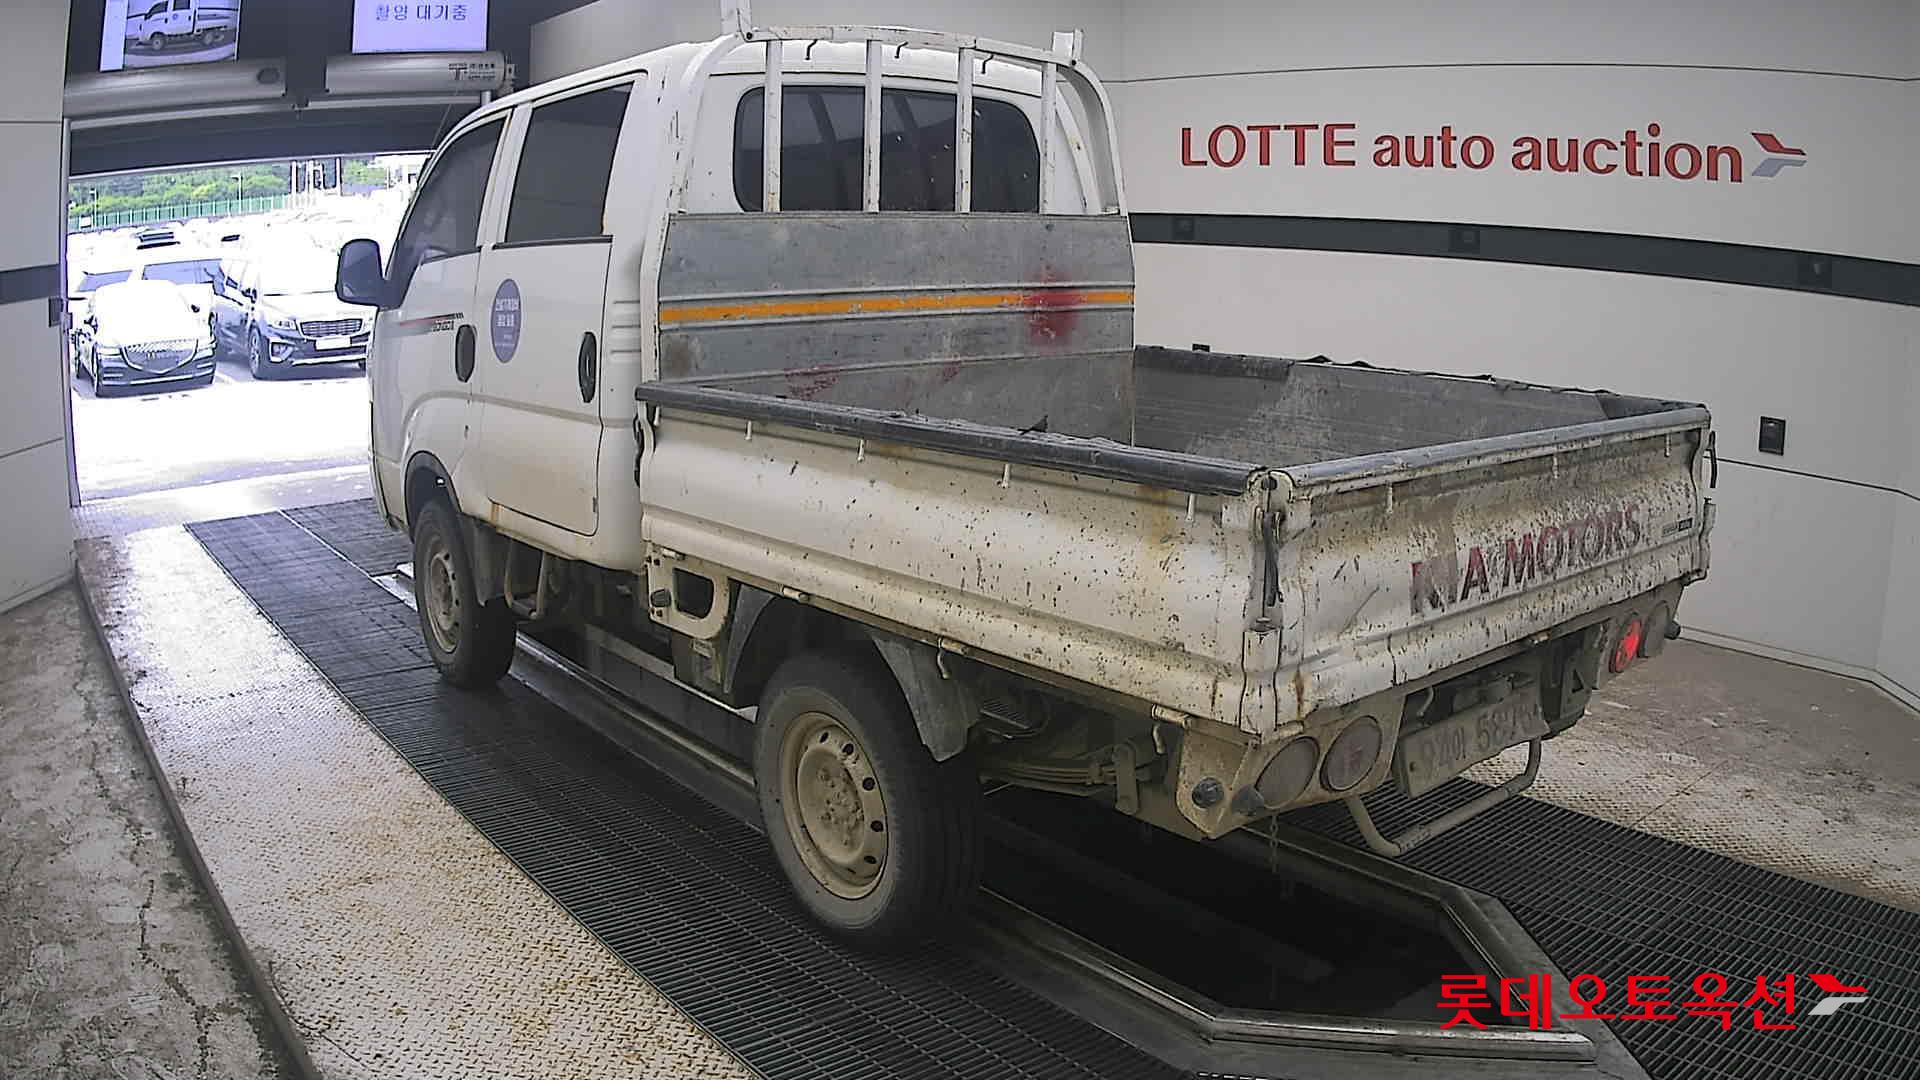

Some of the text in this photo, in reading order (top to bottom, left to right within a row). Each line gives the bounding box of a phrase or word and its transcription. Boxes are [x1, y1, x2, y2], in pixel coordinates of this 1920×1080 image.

[416, 3, 468, 21] 대기중
[1181, 123, 1744, 182] LOTTE auto auction
[1501, 502, 1642, 588] MOTORS
